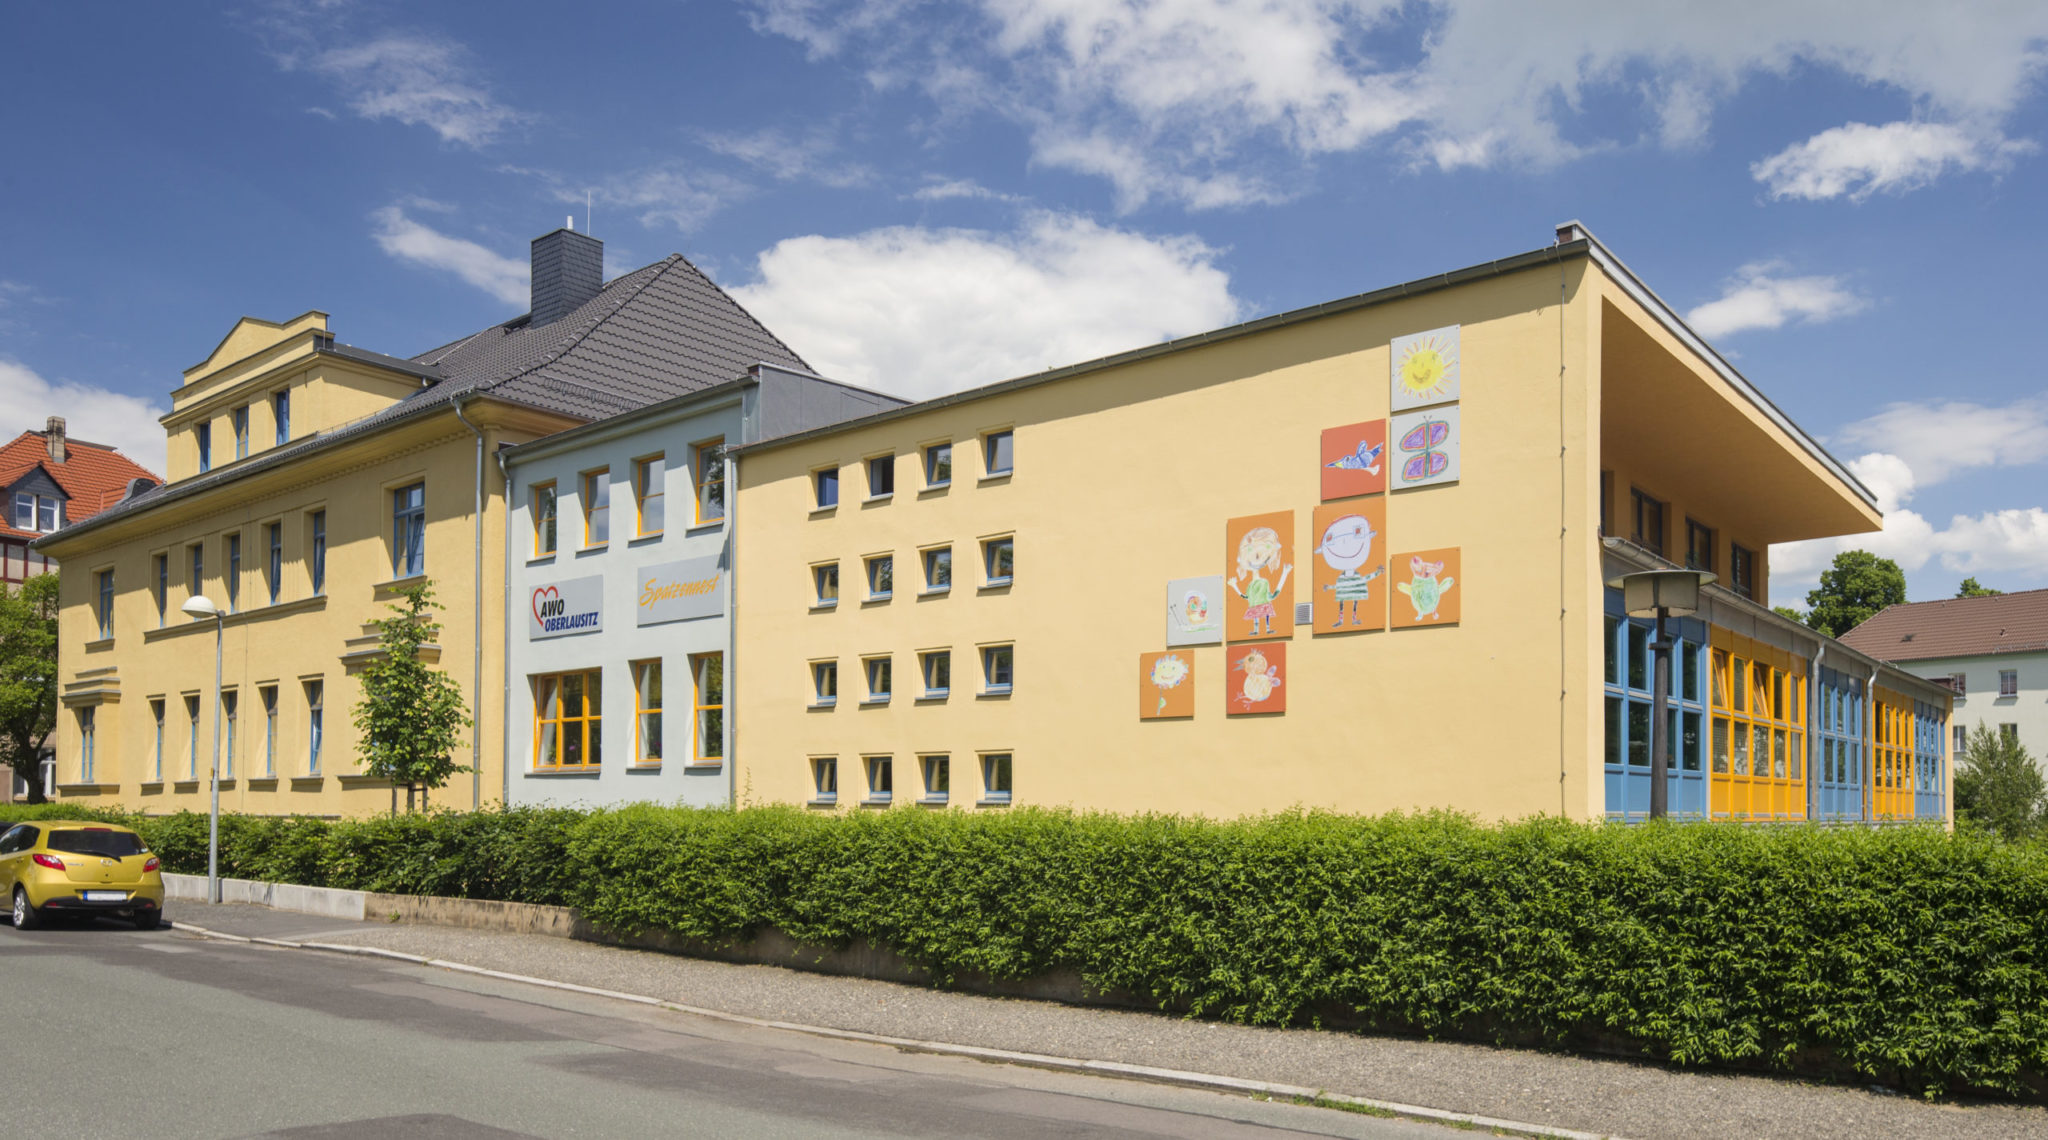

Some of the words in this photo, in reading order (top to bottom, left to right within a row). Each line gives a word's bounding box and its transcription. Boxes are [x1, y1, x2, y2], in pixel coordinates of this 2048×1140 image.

[639, 573, 720, 610] Spatzennest
[540, 598, 565, 618] AWO
[545, 611, 599, 632] OBERLAUSITZ
